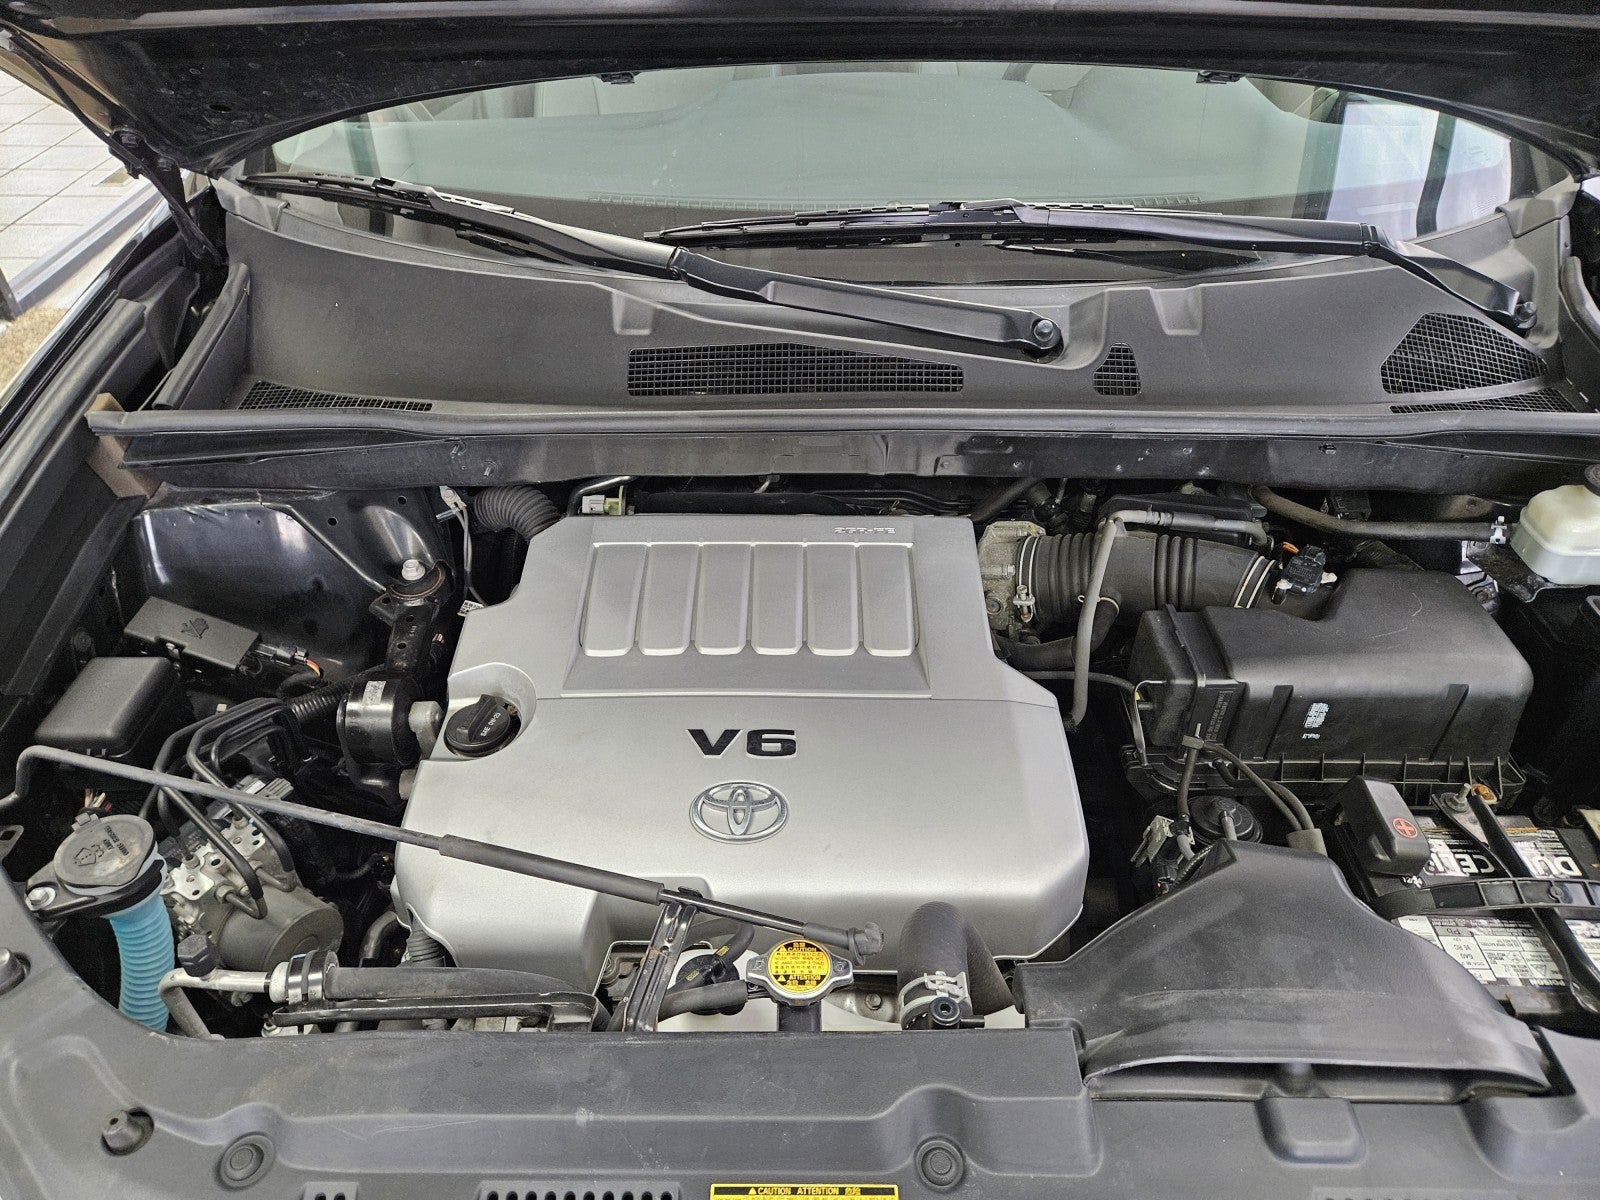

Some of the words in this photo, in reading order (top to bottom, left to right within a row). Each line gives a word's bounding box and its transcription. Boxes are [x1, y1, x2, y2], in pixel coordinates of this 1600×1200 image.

[687, 728, 797, 757] V6
[757, 1187, 791, 1195] CAUTION
[797, 1187, 839, 1195] ATTENTION
